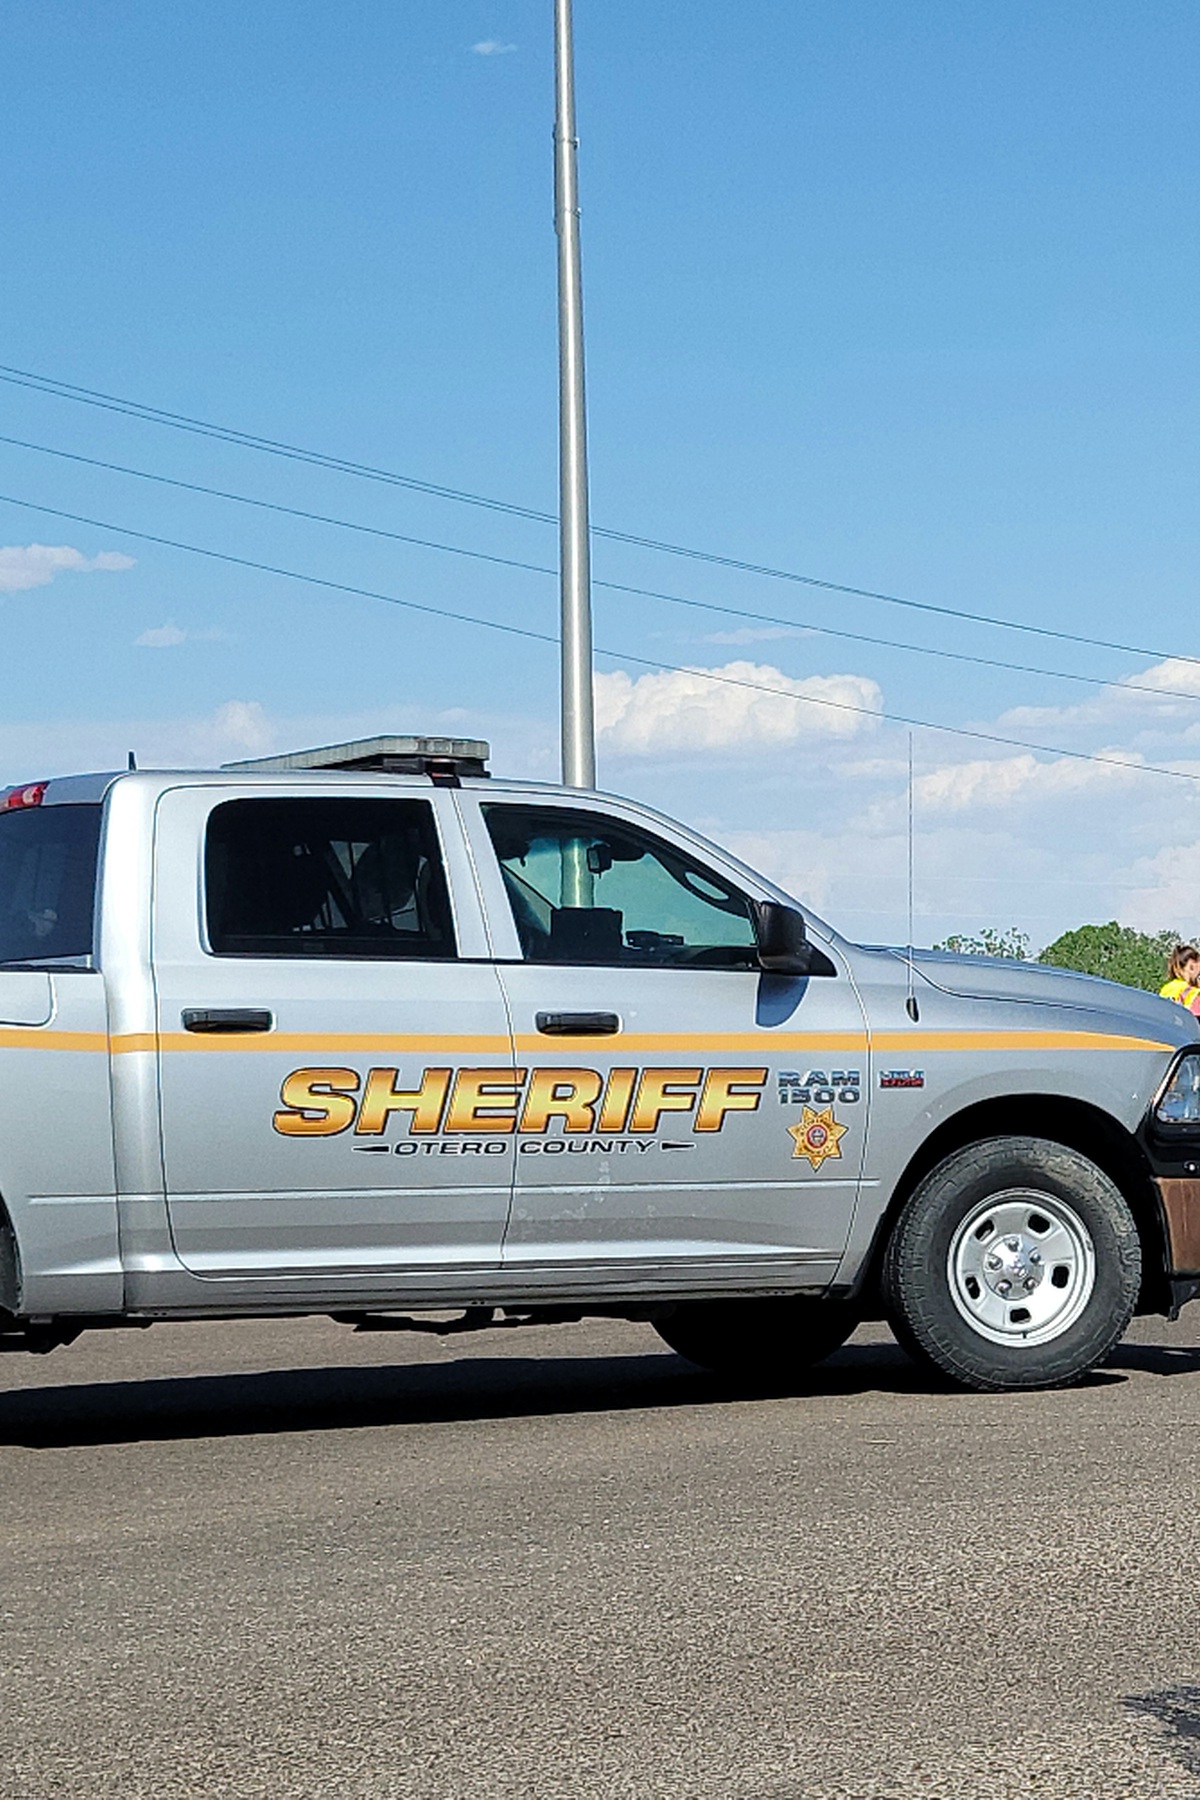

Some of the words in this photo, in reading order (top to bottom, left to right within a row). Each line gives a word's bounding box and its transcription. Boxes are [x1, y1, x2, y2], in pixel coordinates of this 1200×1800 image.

[778, 1070, 860, 1087] RAM
[272, 1067, 768, 1136] SHERIFF
[778, 1087, 860, 1104] 1500
[394, 1141, 508, 1156] OTERO
[519, 1140, 655, 1155] COUNTY
